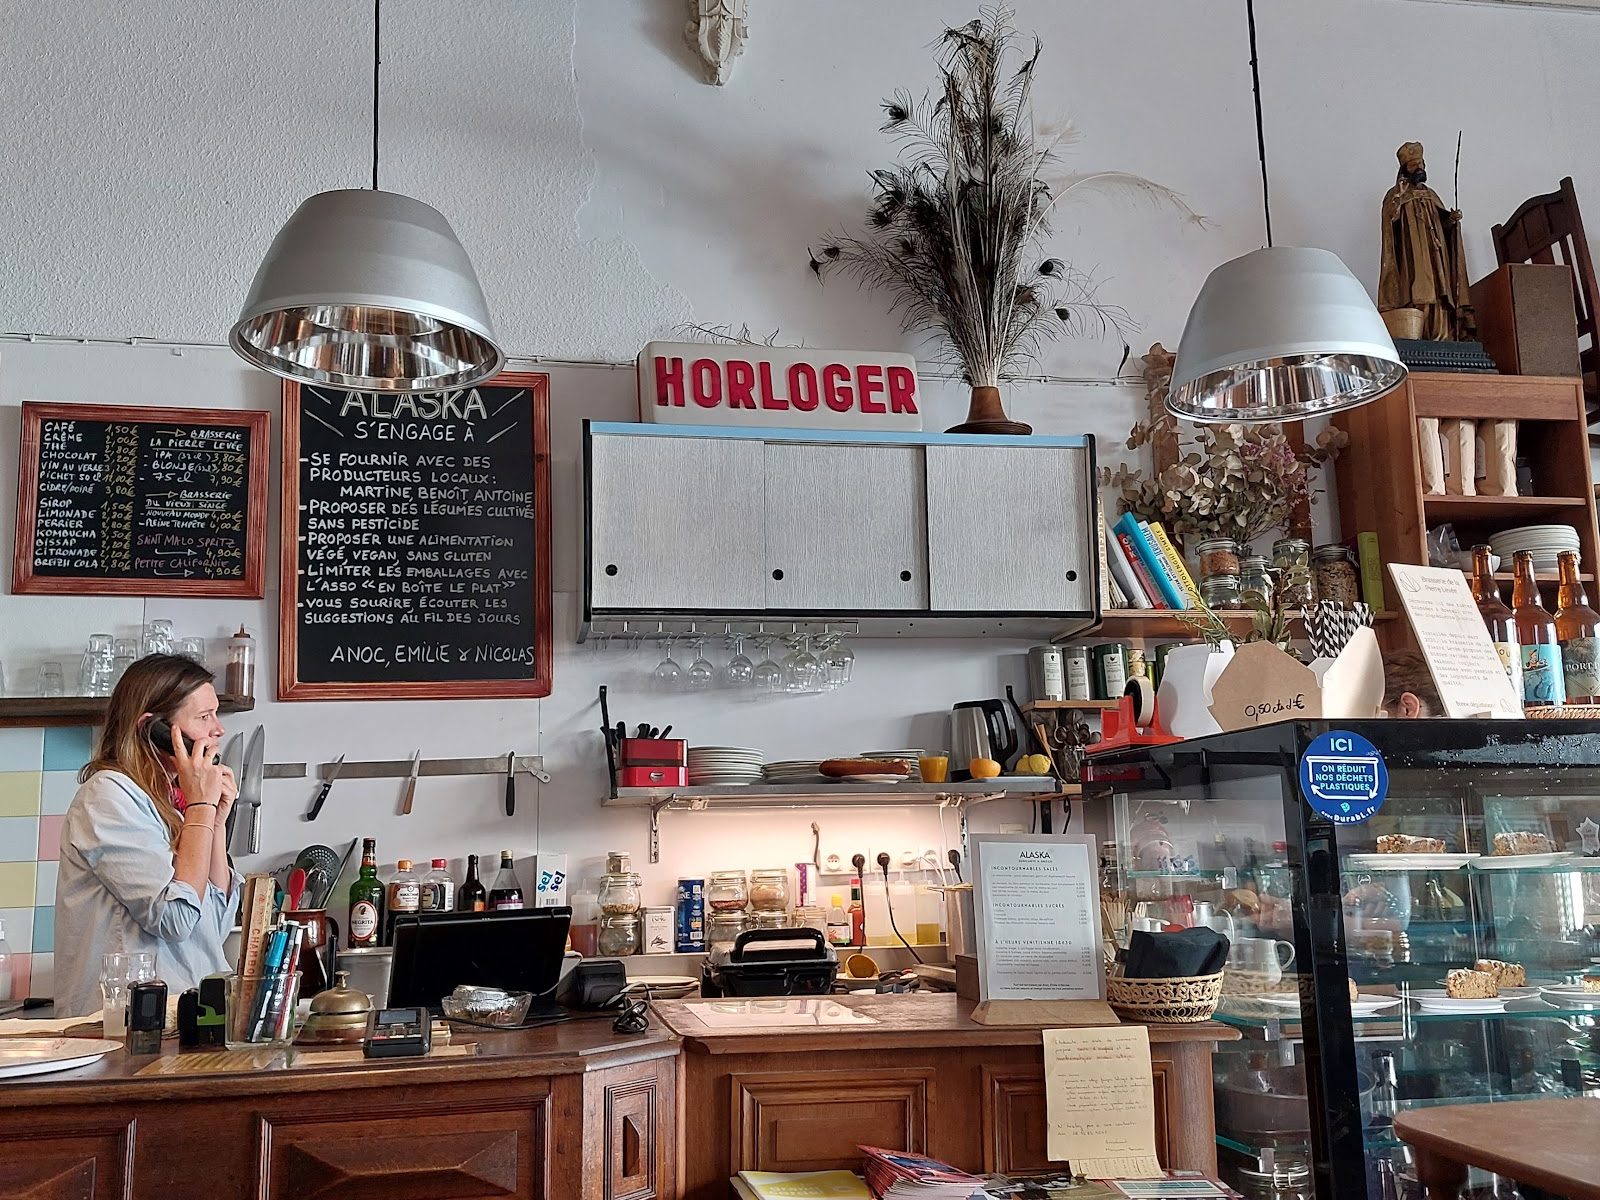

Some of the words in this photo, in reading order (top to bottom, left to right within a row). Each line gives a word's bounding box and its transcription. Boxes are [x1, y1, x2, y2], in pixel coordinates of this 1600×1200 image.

[655, 356, 919, 415] HORLOGER
[339, 388, 488, 420] ALASKA
[44, 421, 76, 432] CAFÉ
[104, 424, 139, 436] 1,50€
[190, 430, 242, 439] BRASSERIE
[354, 421, 456, 441] S'ENGAGE
[464, 420, 476, 442] À
[150, 438, 162, 446] LA
[168, 438, 206, 448] PIERRE
[213, 440, 244, 451] LEVÉE
[42, 451, 98, 461] CHOCOLAT
[156, 449, 172, 459] IPA
[339, 452, 409, 466] FOURNIR
[416, 455, 456, 467] AVEC
[463, 456, 491, 468] DES
[41, 461, 60, 470] VIN
[78, 464, 103, 472] VERRE
[152, 460, 194, 470] BLONDE
[40, 470, 76, 480] PICHET
[152, 472, 176, 480] 75
[210, 474, 244, 487] 7,90€
[310, 468, 422, 483] PRODUCTEURS
[180, 490, 232, 499] BRASSERIE
[474, 489, 534, 503] ANTOINE
[40, 496, 72, 508] SIROP
[100, 500, 134, 512] 1,50€
[145, 499, 160, 508] DU
[166, 500, 191, 508] VIEUX
[198, 501, 228, 510] SINGE
[392, 503, 418, 514] DES
[424, 500, 482, 516] LÉGUMES
[487, 504, 534, 519] CULTIVÉS
[38, 508, 96, 518] LIMONADE
[37, 518, 84, 528] PERRIER
[308, 518, 345, 530] SANS
[352, 517, 420, 530] PESTICIDE
[36, 530, 96, 538] KOMBUCHA
[388, 534, 415, 545] UNE
[419, 534, 514, 546] ALIMENTATION
[36, 538, 76, 547] BISSAP
[137, 534, 163, 546] SAINT
[164, 534, 194, 546] MALO
[196, 537, 236, 548] SPRITZ
[1156, 530, 1170, 552] SIMPLE
[35, 546, 98, 557] CITRONADE
[206, 548, 242, 560] 4,90€
[406, 551, 440, 561] SANS
[444, 551, 492, 562] GLUTEN
[74, 560, 98, 568] COLA
[134, 557, 165, 569] PETITE
[170, 558, 229, 568] CALIFORNIE
[204, 565, 242, 579] 4,90€
[378, 566, 402, 578] LES
[406, 567, 490, 578] EMBALLAGES
[498, 568, 528, 580] AVEC
[1169, 554, 1194, 592] OTTOLENGHI
[306, 577, 356, 592] L'ASSO
[402, 580, 443, 593] BOÎTE
[449, 582, 466, 593] LE
[419, 596, 479, 608] ÉCOUTER
[485, 599, 508, 608] LES
[304, 612, 394, 624] SUGGESTIONS
[400, 614, 420, 624] AU
[424, 612, 444, 623] FIL
[446, 612, 472, 624] DES
[478, 613, 521, 625] JOURS
[330, 645, 390, 668] ANOC,
[394, 642, 450, 663] EMILIE
[475, 644, 534, 665] NICOLAS
[1244, 703, 1271, 721] 0,50
[1330, 738, 1352, 752] ICI
[1322, 764, 1335, 772] ON
[1337, 764, 1366, 773] RÉDUIT
[1336, 773, 1374, 782] DÉCHETS
[1320, 782, 1370, 792] PLASTIQUES
[538, 871, 554, 892] sel
[550, 870, 566, 892] sel
